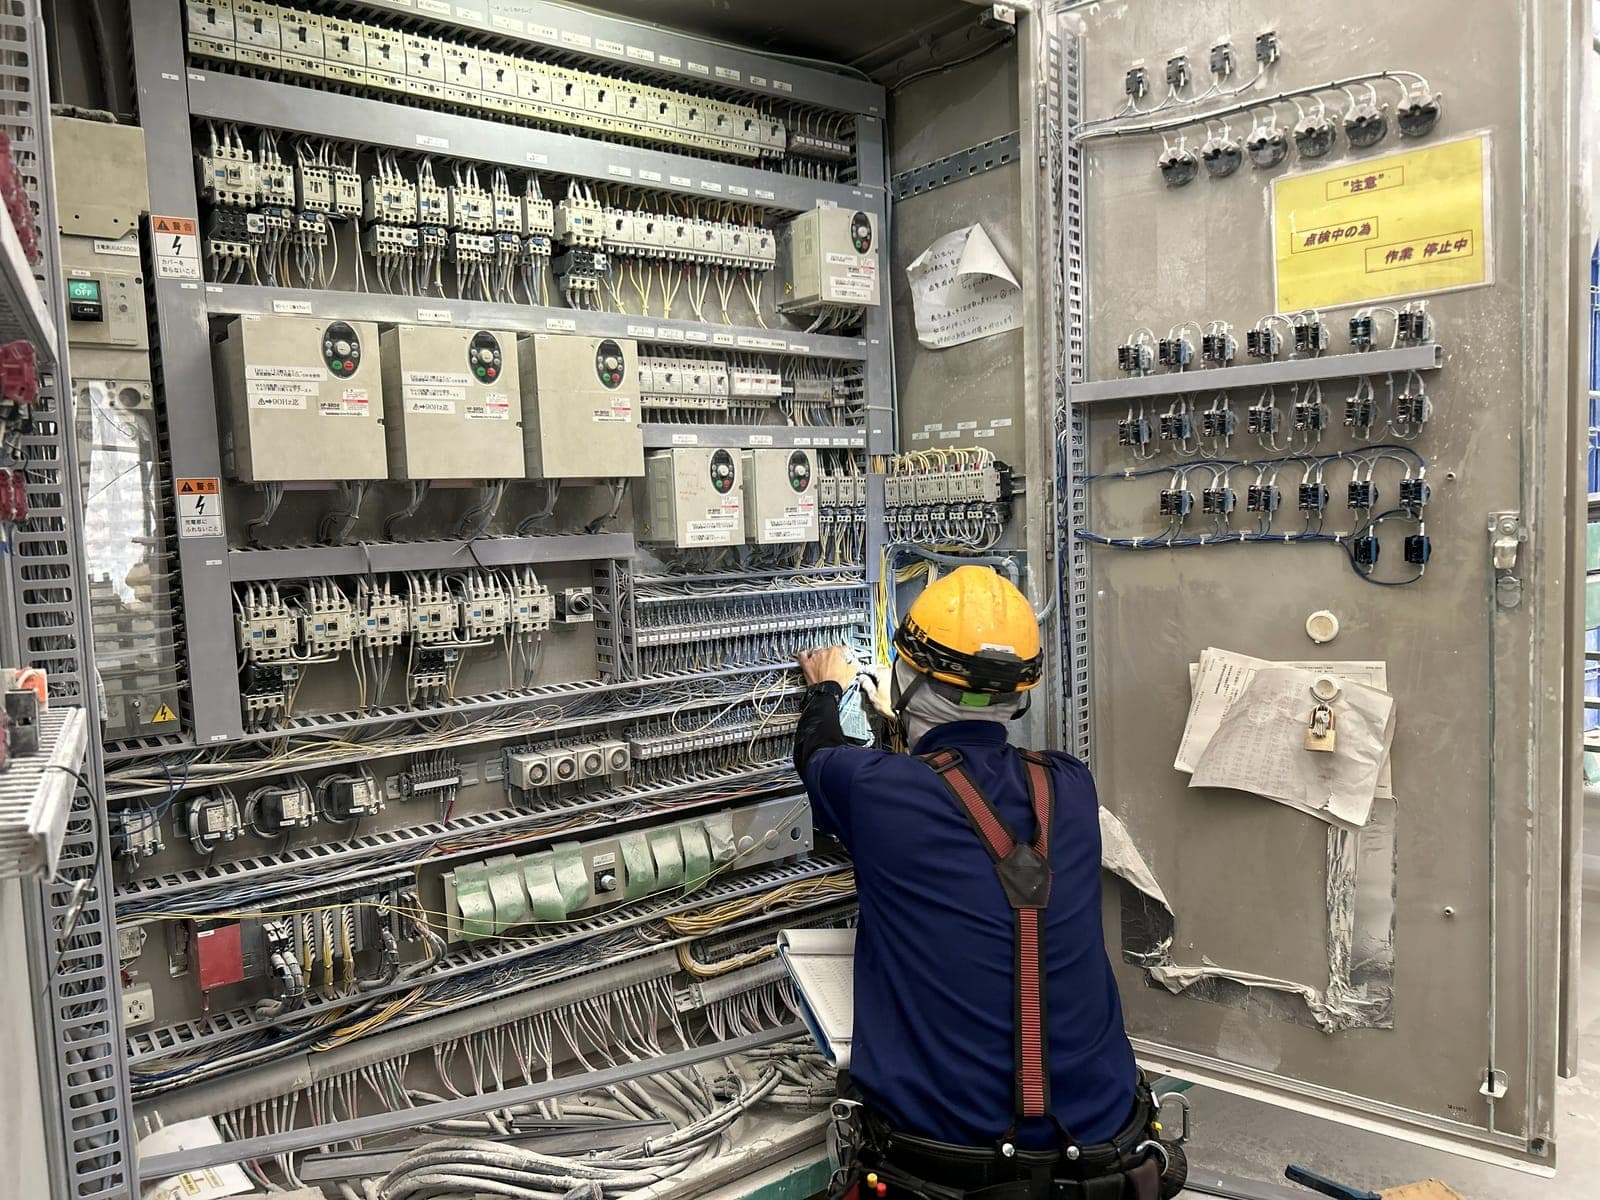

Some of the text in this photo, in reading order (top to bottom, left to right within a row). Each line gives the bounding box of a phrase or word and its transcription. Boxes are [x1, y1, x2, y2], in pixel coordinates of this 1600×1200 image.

[1303, 222, 1371, 247] 点検中の為
[1384, 237, 1468, 265] 作業 停止中
[74, 288, 92, 297] OFF
